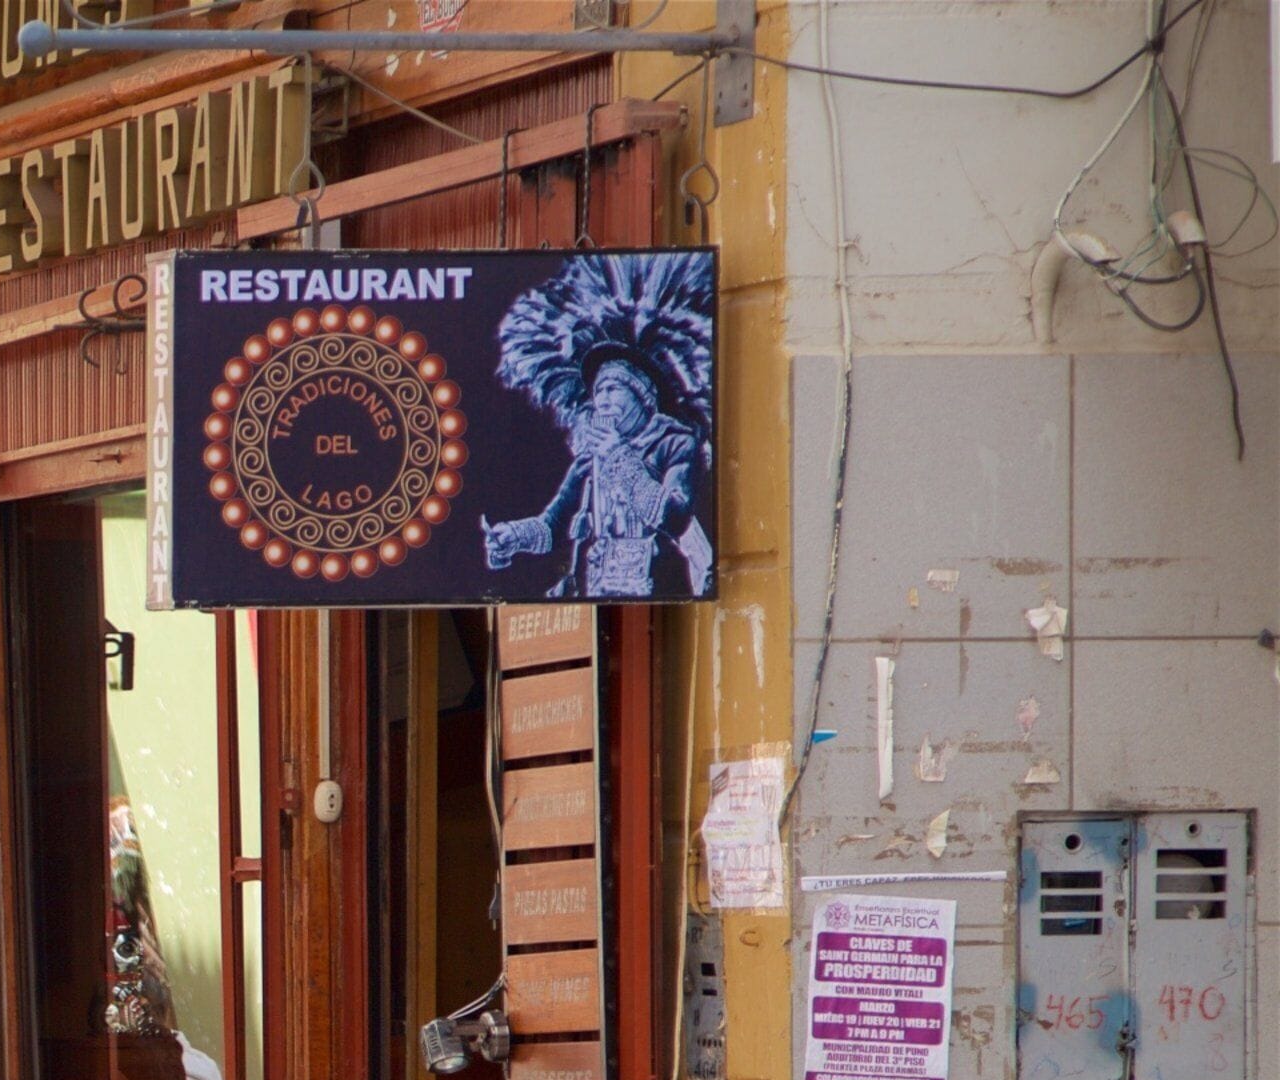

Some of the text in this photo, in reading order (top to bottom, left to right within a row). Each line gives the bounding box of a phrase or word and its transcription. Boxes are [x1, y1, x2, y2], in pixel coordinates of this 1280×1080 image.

[200, 267, 472, 303] RESTAURANT
[272, 374, 397, 441] TRADICIONES
[153, 263, 171, 603] RESTAURANT
[315, 433, 358, 456] DEL
[301, 483, 373, 511] LAGO
[836, 878, 862, 888] ERES
[854, 913, 940, 930] METAFÍSICA
[849, 936, 913, 952] CLAVES DE
[819, 950, 943, 966] SAINT GERMAIN PARA LA
[835, 984, 923, 999] CON MAURO VITALI
[858, 1001, 896, 1014] MARZO
[1157, 985, 1226, 1022] 470
[1046, 993, 1110, 1031] 465
[862, 1015, 886, 1026] JUEV
[886, 1016, 900, 1027] 20
[905, 1017, 928, 1028] VIER
[928, 1019, 941, 1029] 21
[822, 1042, 930, 1057] MUNICIPALIDAD DE PUNO
[874, 1055, 891, 1065] DEL
[904, 1057, 926, 1067] PISO
